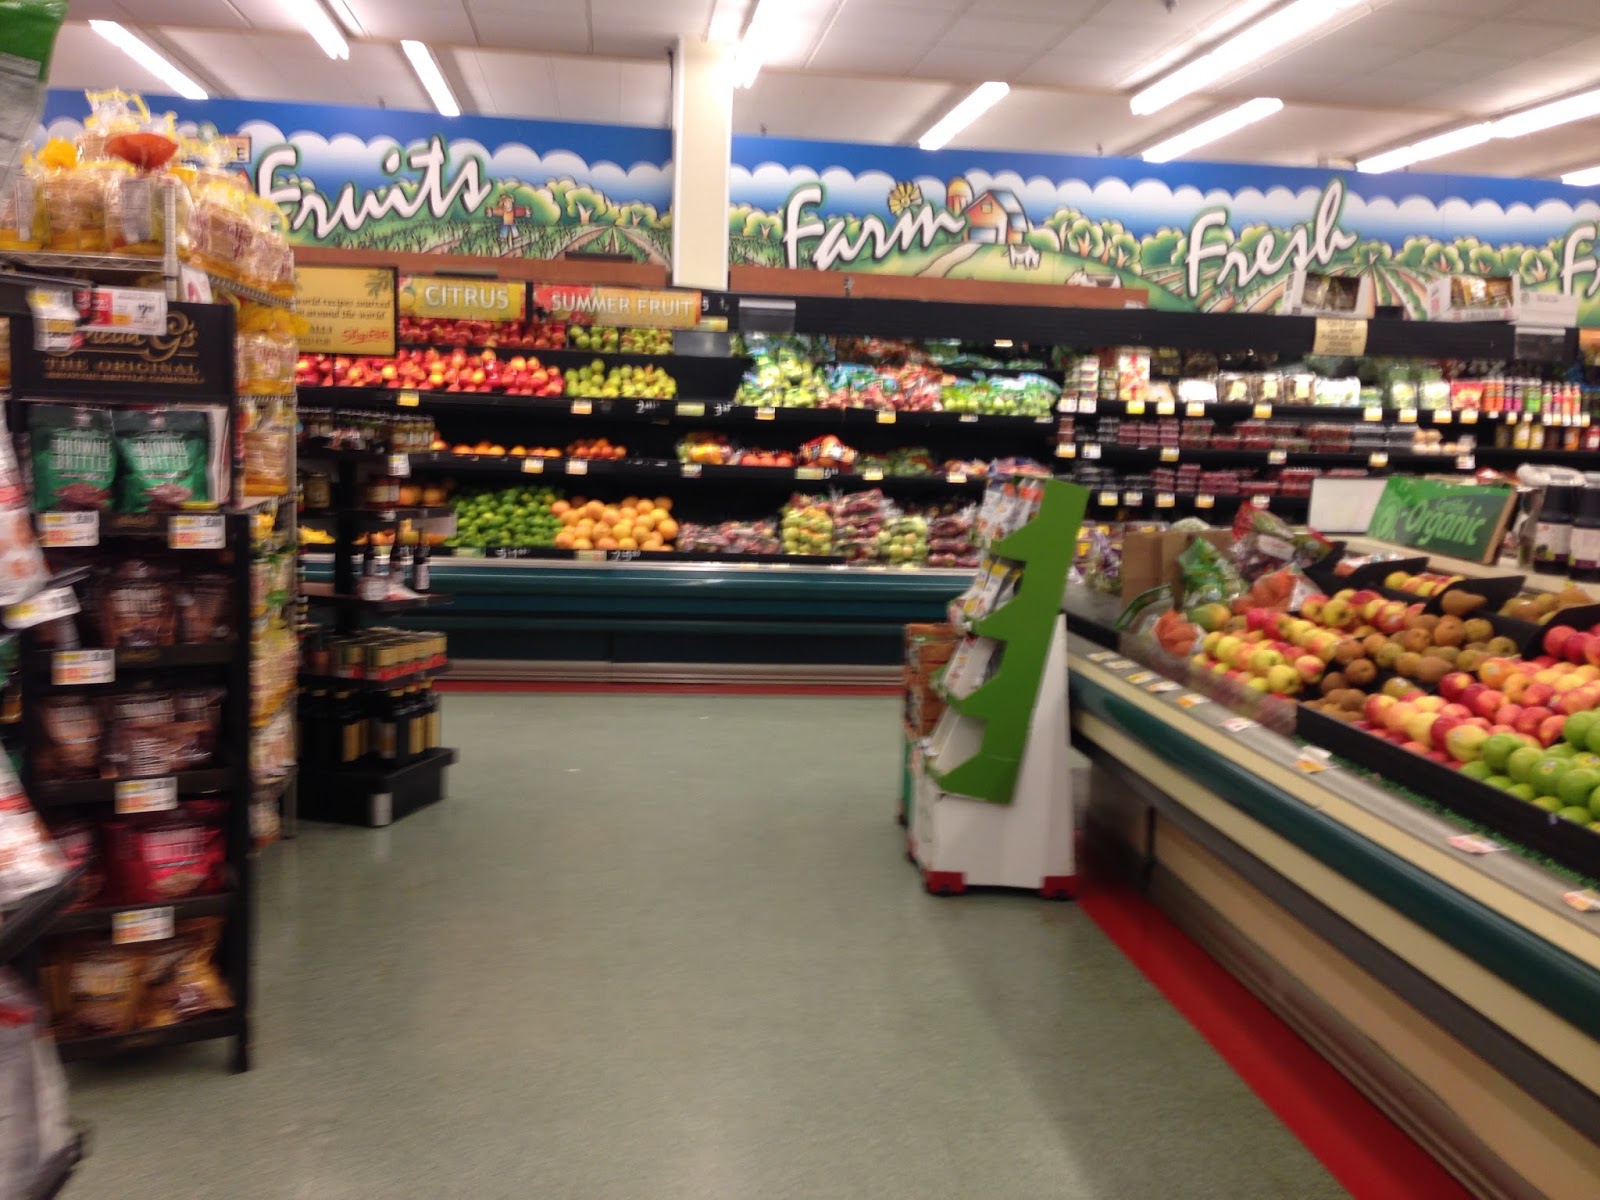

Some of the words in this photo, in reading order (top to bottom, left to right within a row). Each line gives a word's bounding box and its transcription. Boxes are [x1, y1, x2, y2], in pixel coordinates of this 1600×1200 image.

[257, 136, 493, 239] Fruits
[782, 184, 966, 271] Farm
[1185, 177, 1358, 297] Fresh
[424, 284, 510, 310] CITRUS
[551, 290, 631, 314] SUMMER
[637, 296, 694, 317] FRUIT
[1405, 500, 1487, 546] Organic
